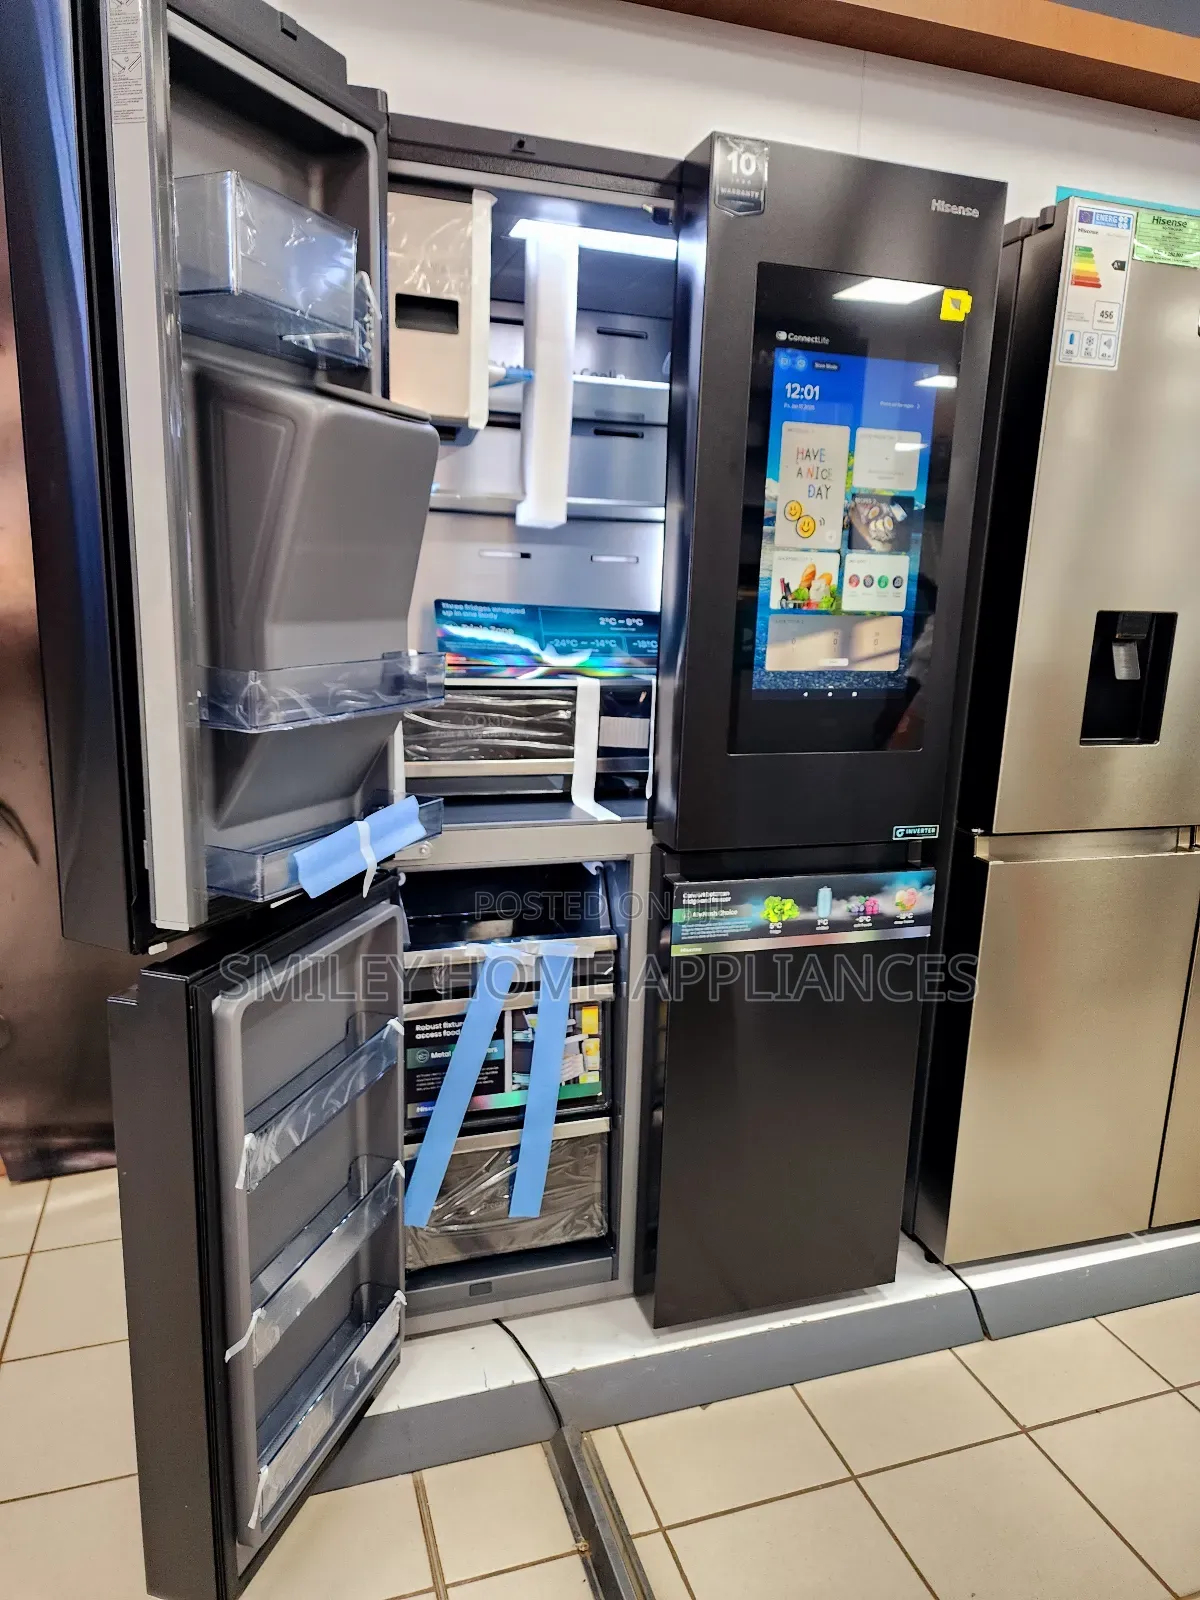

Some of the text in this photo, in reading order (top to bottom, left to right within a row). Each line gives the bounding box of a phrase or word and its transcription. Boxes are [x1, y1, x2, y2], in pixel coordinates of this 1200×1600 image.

[727, 150, 756, 176] 10
[931, 198, 980, 219] Hisense
[1096, 213, 1118, 223] ENERG
[1152, 215, 1188, 228] Hisense
[1100, 310, 1114, 319] 456
[788, 332, 831, 345] ConnectLife
[785, 382, 820, 401] 12:01
[796, 446, 826, 464] HAVE
[796, 465, 833, 481] A NICE
[807, 484, 832, 501] DAY
[442, 610, 453, 618] up
[905, 827, 936, 835] INVERTER
[415, 1021, 464, 1032] Robust fixtur
[415, 1028, 461, 1040] access food
[430, 1051, 452, 1059] Metal
